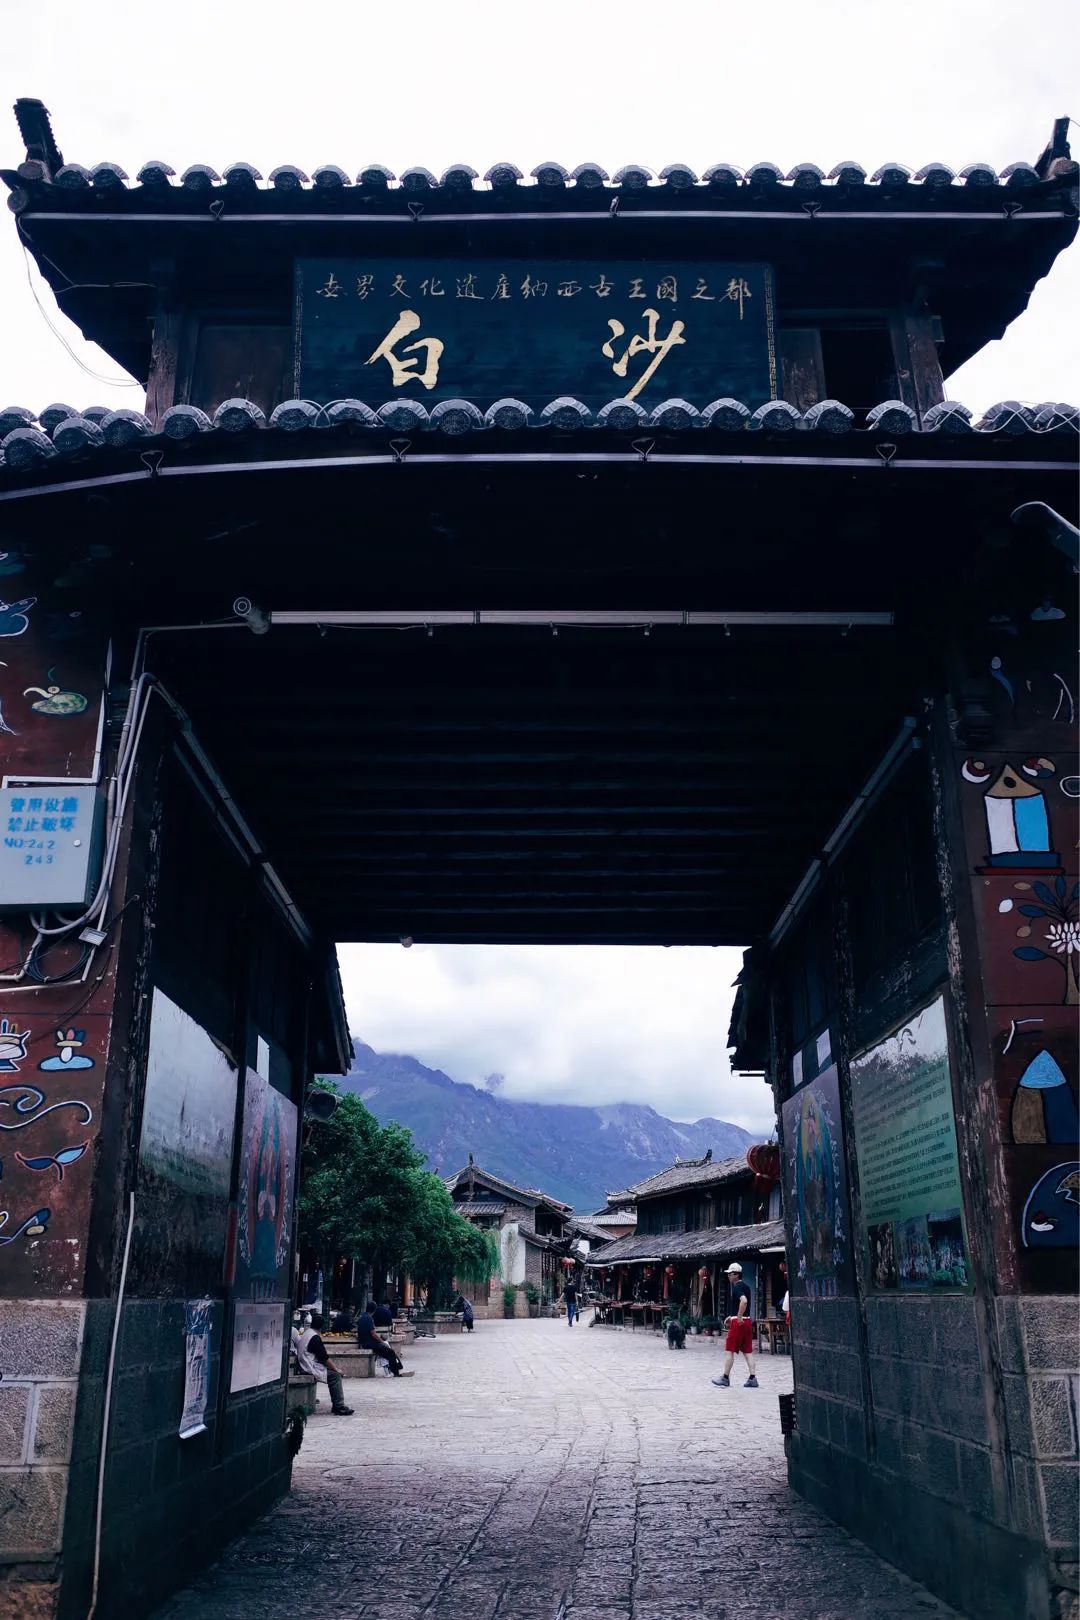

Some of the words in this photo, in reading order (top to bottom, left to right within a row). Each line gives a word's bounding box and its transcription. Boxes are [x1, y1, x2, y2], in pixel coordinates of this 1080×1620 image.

[364, 308, 687, 400] 白沙
[8, 816, 74, 832] 禁止破坏
